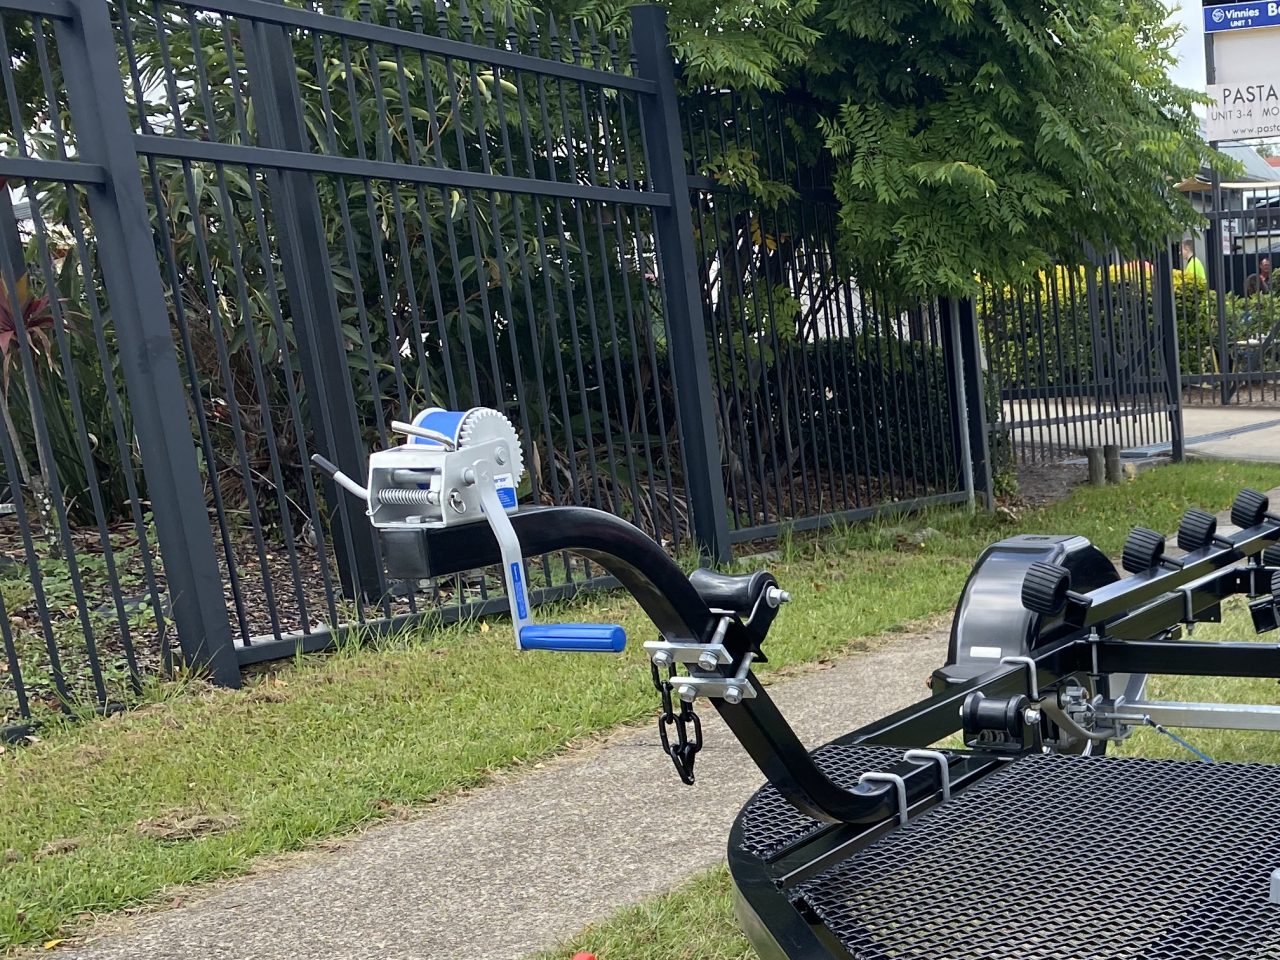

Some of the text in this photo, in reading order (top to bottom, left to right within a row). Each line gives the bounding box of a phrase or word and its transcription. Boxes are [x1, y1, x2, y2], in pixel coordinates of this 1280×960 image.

[1225, 8, 1259, 19] Vinnies
[1223, 84, 1278, 105] PASTA
[1211, 110, 1233, 121] UNIT
[1236, 109, 1253, 119] 3-4
